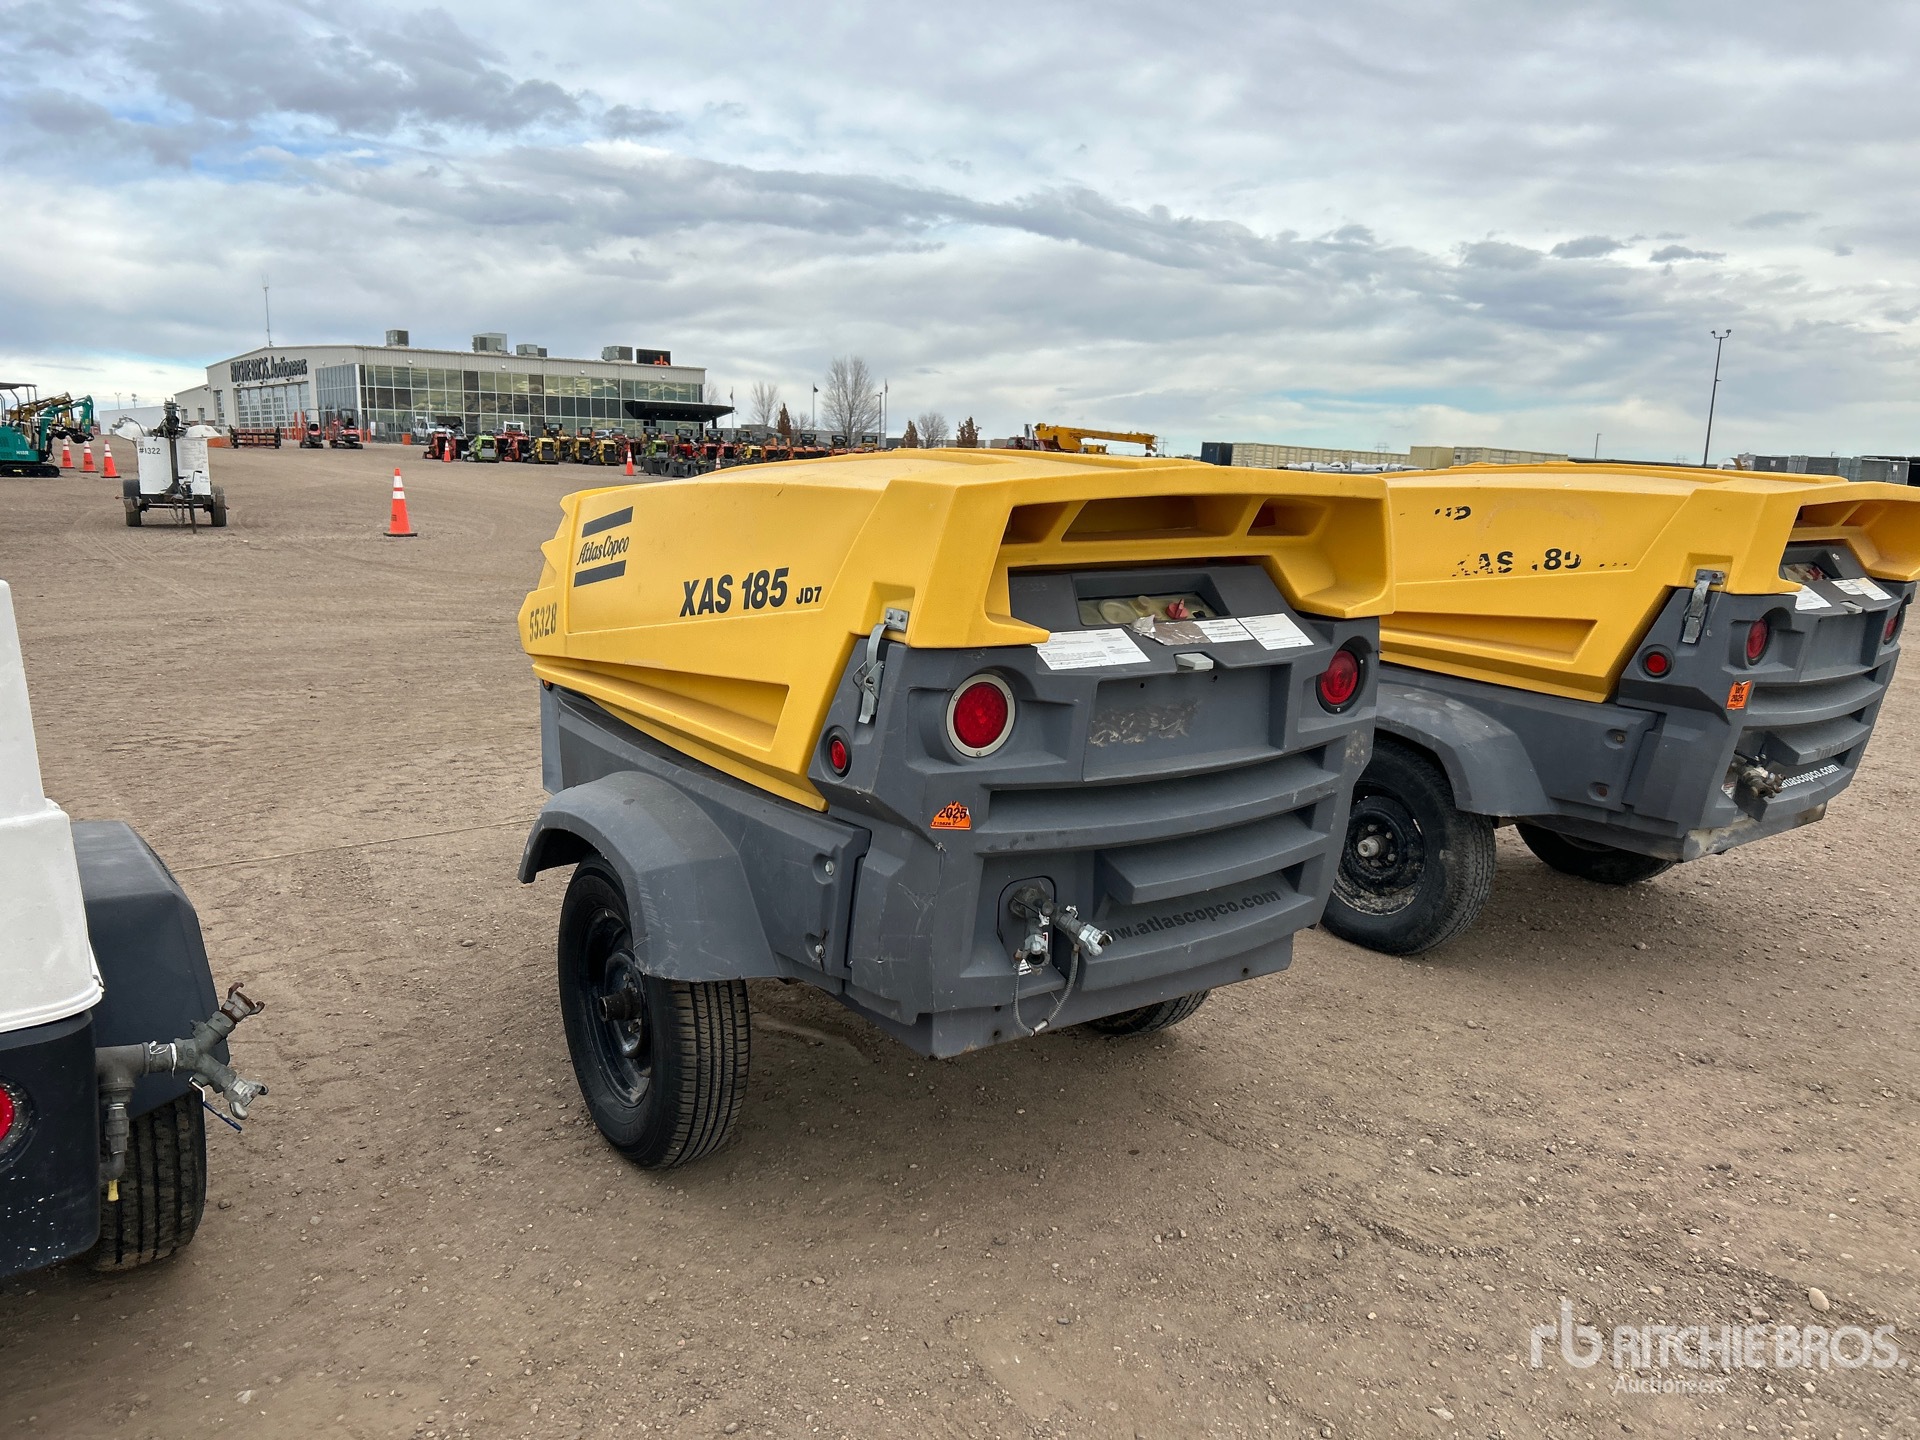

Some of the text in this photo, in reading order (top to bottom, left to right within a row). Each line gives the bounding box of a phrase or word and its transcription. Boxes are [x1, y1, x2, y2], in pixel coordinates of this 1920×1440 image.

[139, 447, 161, 455] #1322
[679, 566, 823, 618] XAS 185 JD7
[529, 601, 558, 643] 55328
[939, 807, 968, 819] 2025
